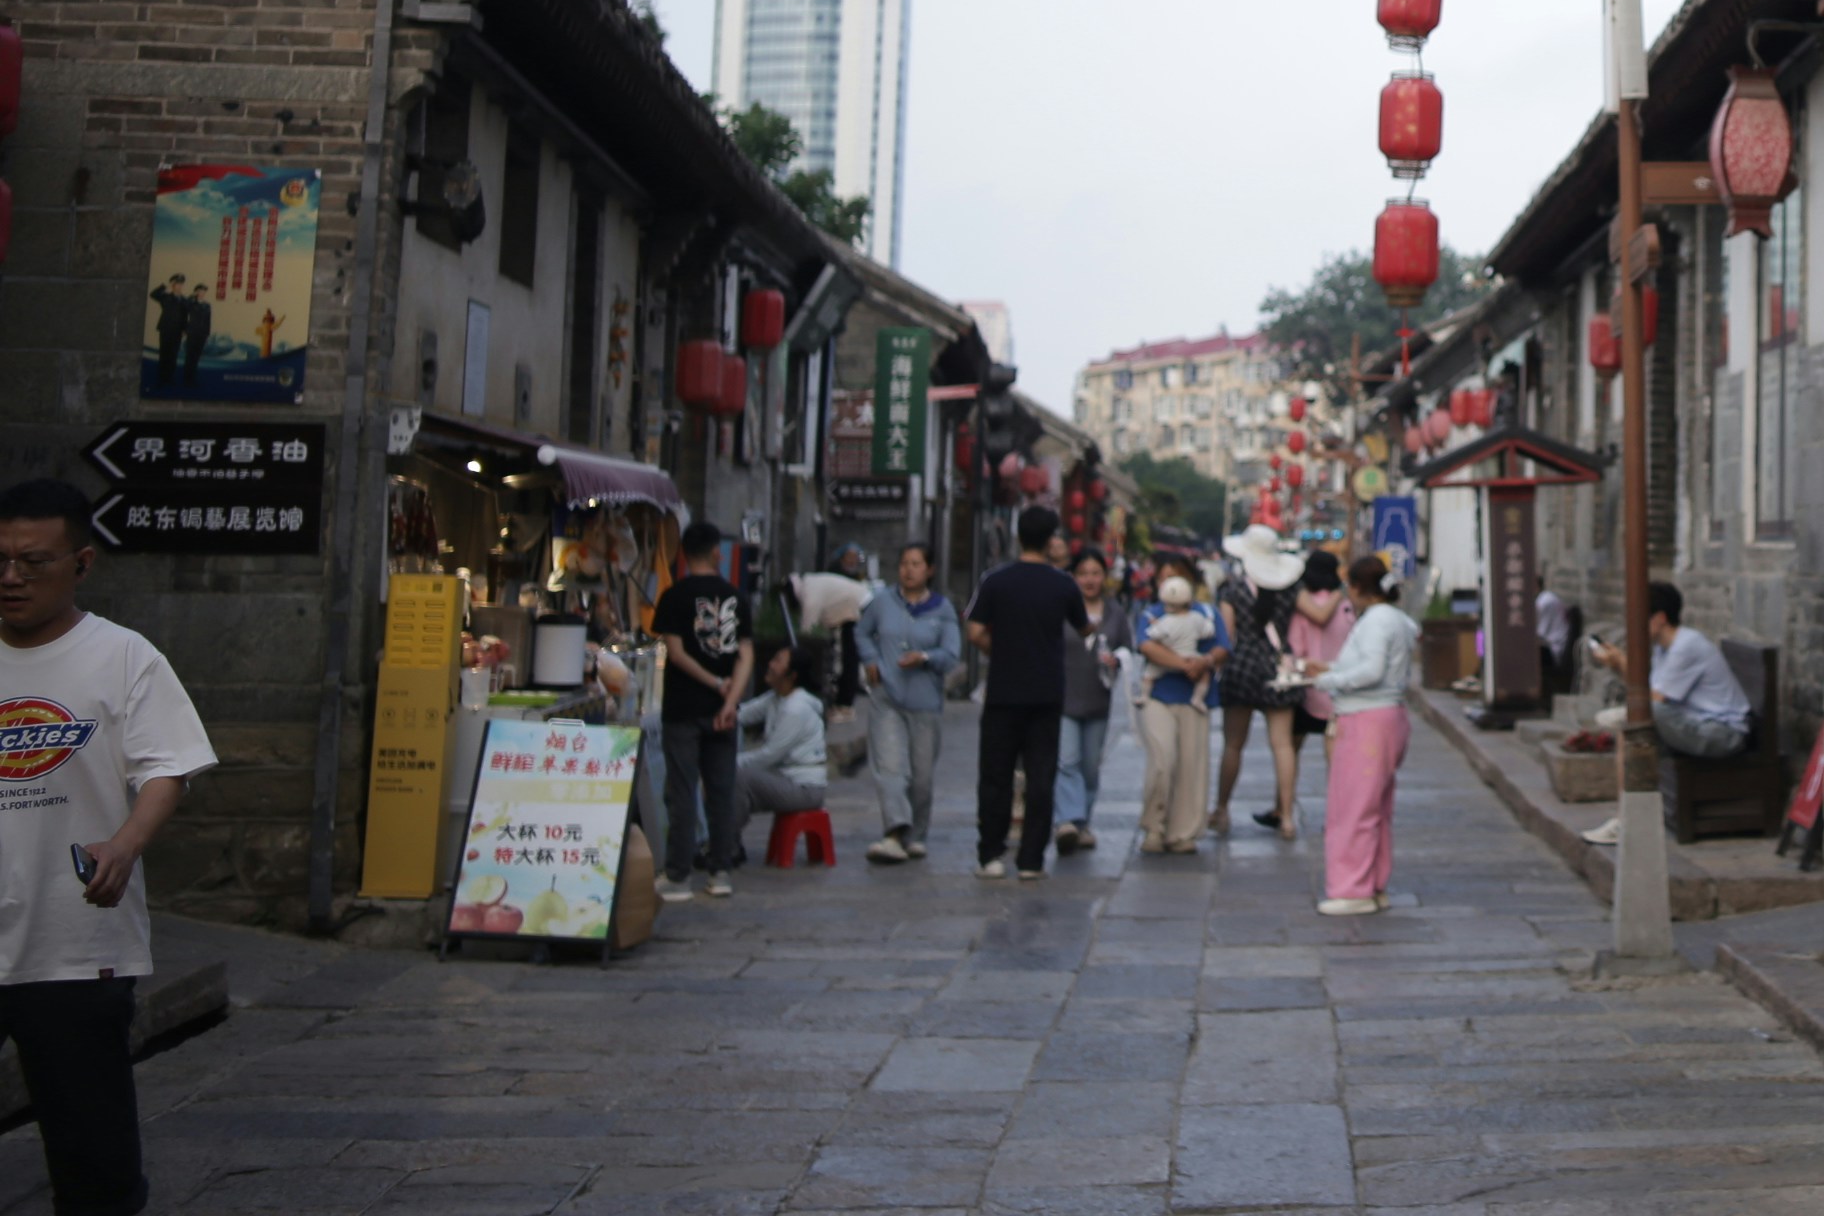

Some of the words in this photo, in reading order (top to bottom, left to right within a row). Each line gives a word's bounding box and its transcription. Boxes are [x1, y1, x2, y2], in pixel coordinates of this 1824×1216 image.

[131, 437, 309, 464] 界河香油
[545, 730, 588, 753] 烟台
[495, 824, 538, 842] 大杯
[544, 824, 584, 842] 10元
[494, 847, 555, 866] 特大杯
[562, 848, 601, 866] 15元
